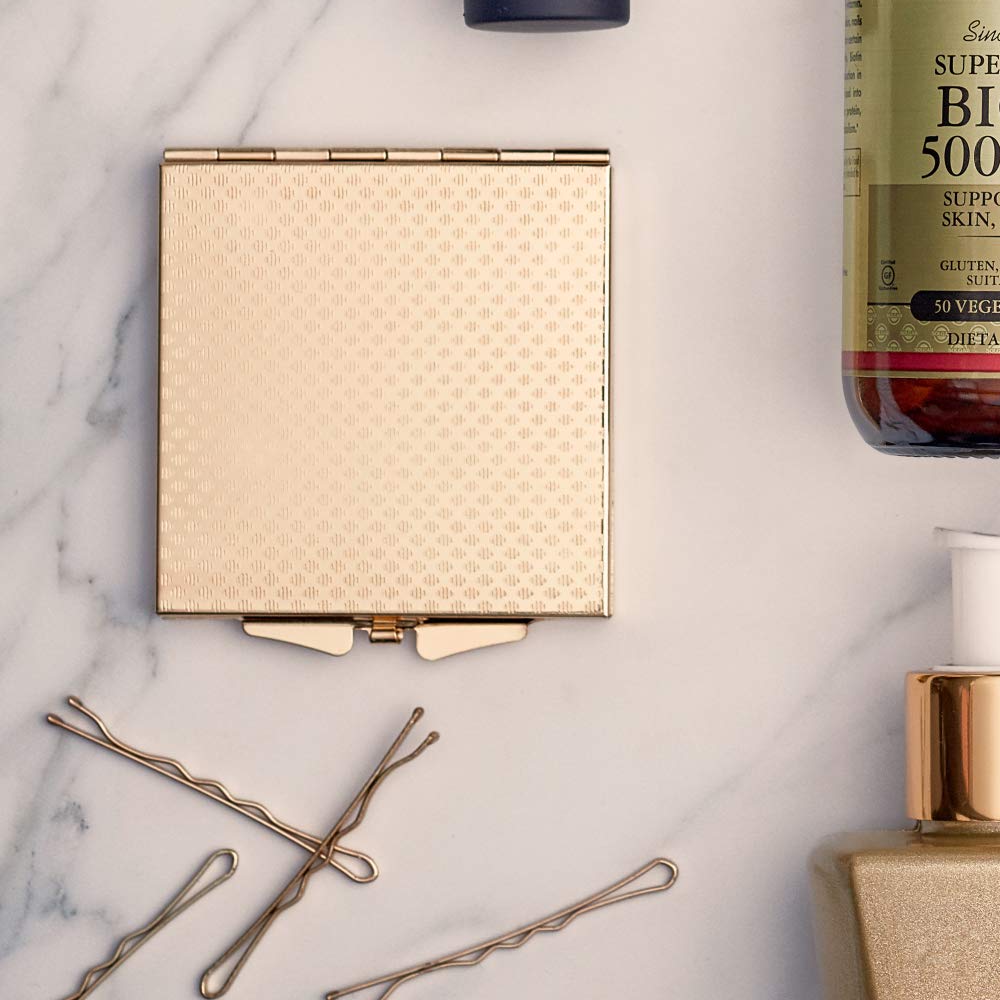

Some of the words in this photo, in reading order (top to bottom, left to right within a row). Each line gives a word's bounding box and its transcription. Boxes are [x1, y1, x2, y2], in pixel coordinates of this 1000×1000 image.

[942, 212, 995, 229] SKIN,
[940, 260, 998, 273] GLUTEN,
[934, 300, 951, 314] 50
